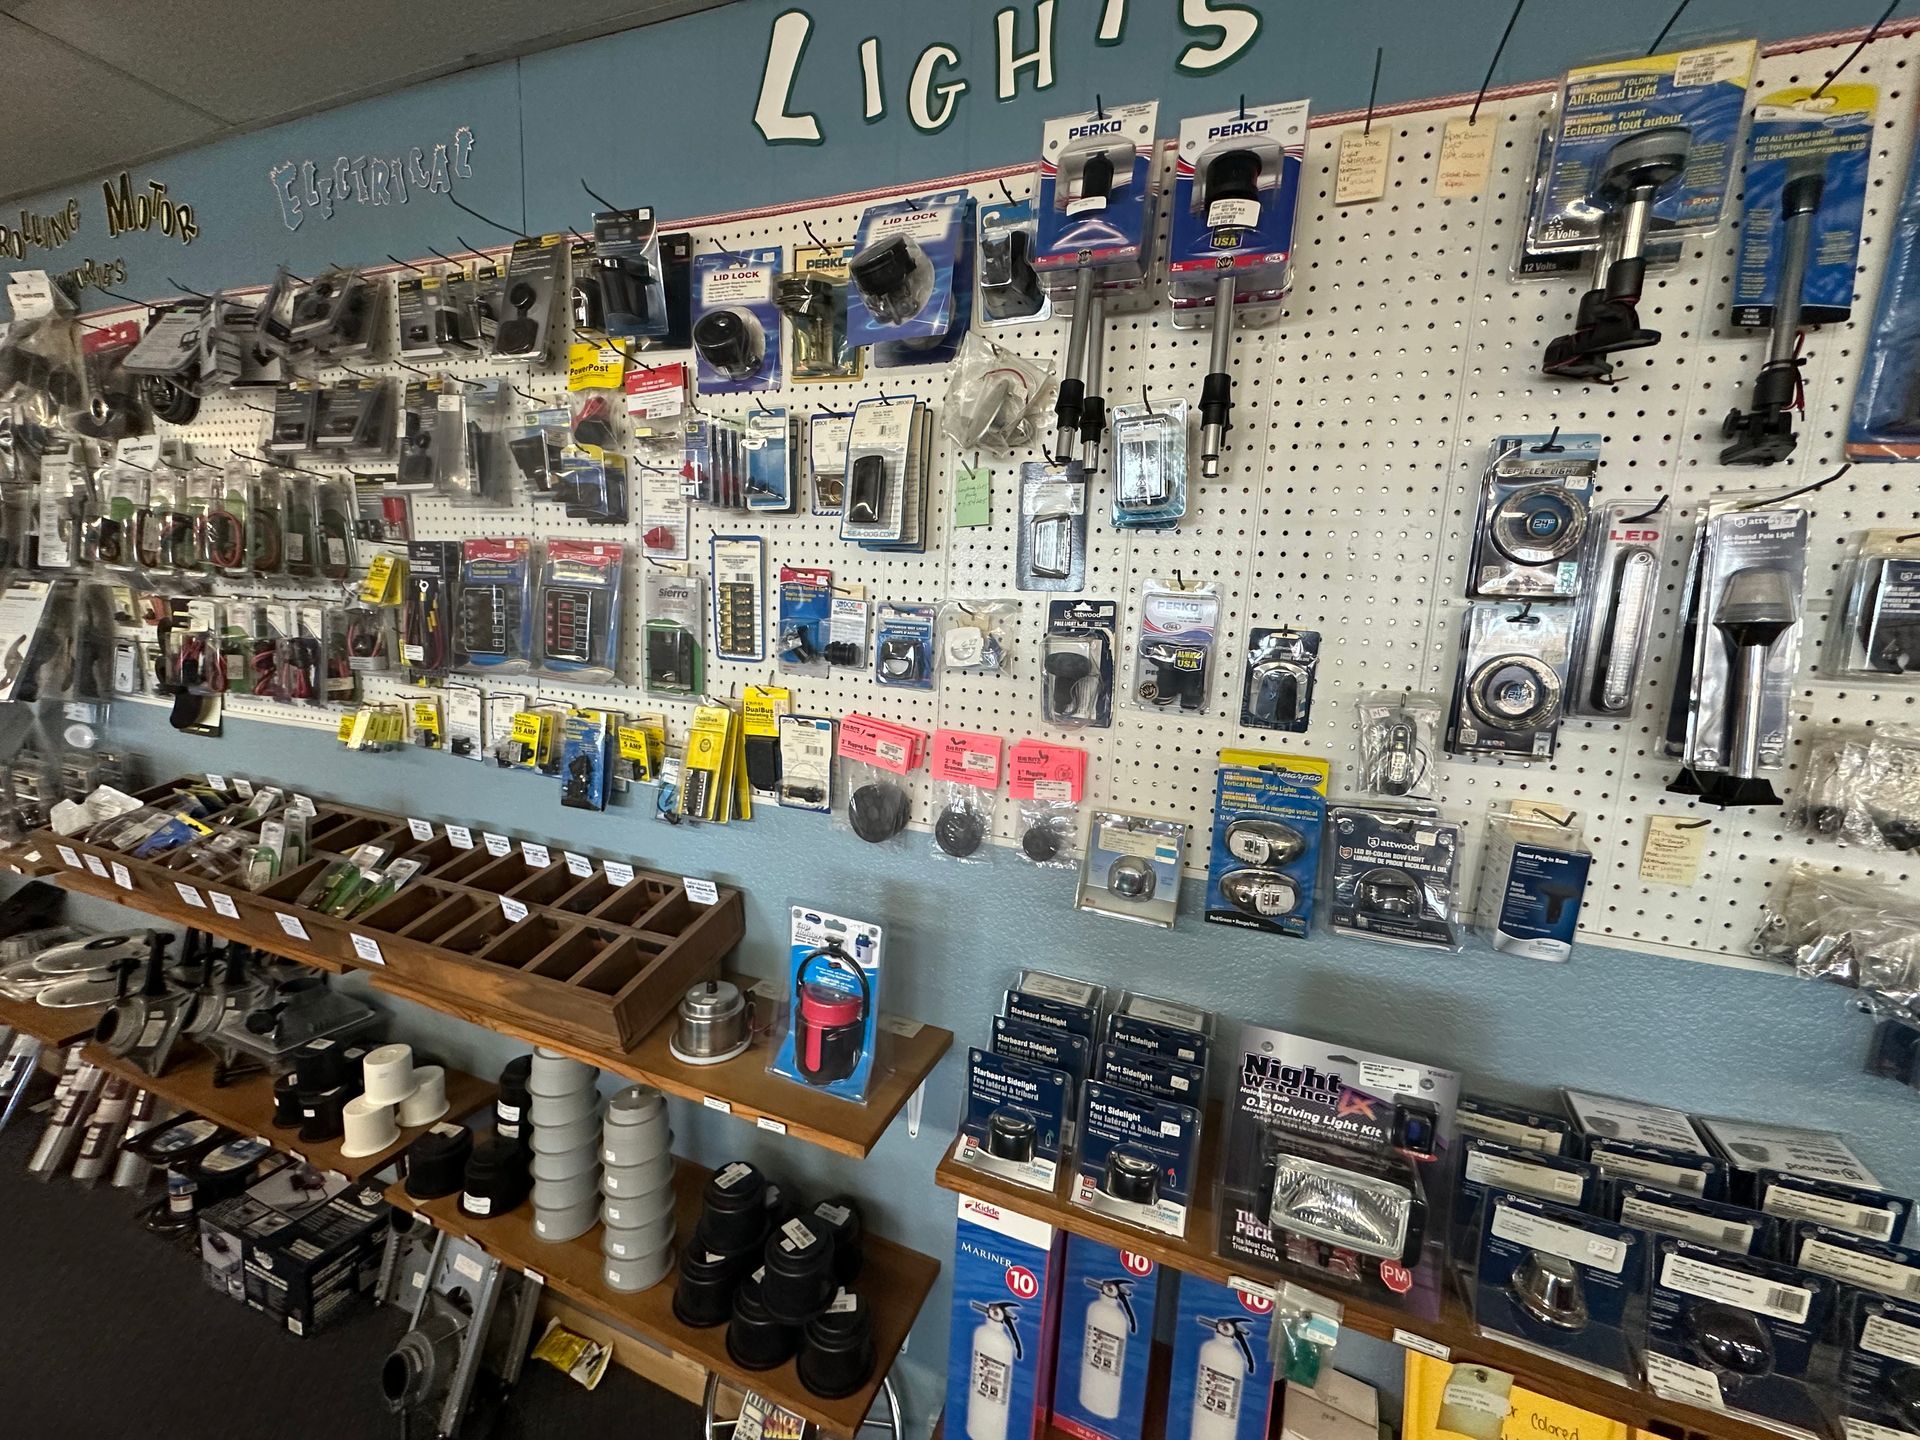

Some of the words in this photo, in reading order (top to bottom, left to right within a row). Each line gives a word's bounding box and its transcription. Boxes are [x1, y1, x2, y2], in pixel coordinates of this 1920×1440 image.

[1624, 75, 1659, 87] FOLDING
[1568, 92, 1625, 106] All-Round
[1628, 85, 1657, 99] Light
[1618, 109, 1646, 119] PLIANT
[1068, 120, 1122, 139] PERKO
[1208, 119, 1268, 139] PERKO
[1564, 123, 1616, 137] Eclairage
[1619, 118, 1641, 131] tout
[1643, 113, 1683, 128] autour
[1770, 135, 1782, 143] ALL
[270, 126, 474, 231] ELECTRICAL
[102, 171, 199, 246] MOTOR
[883, 217, 902, 225] LID
[905, 212, 938, 221] LOCK
[1213, 236, 1237, 246] USA
[1544, 230, 1554, 240] 12
[1556, 229, 1580, 239] Volts
[1535, 262, 1557, 271] Volts
[713, 273, 729, 281] LID
[732, 271, 760, 279] LOCK
[569, 363, 609, 376] PowerPost
[1609, 530, 1660, 541] LED
[1759, 532, 1774, 540] Pole
[1776, 531, 1795, 539] Light
[658, 588, 689, 598] Sierra
[1157, 601, 1200, 612] PERKO
[1177, 660, 1198, 669] USA
[746, 706, 774, 714] DualBus
[524, 728, 537, 736] AMP
[629, 742, 642, 751] AMP
[1277, 772, 1322, 783] marpac
[1265, 783, 1279, 791] Side
[1279, 785, 1297, 793] Lights
[1296, 808, 1318, 817] vertical
[1380, 840, 1420, 851] attwood
[1010, 1006, 1039, 1021] Starboard
[1041, 1014, 1067, 1027] Sidelight
[997, 1033, 1028, 1048] Starboard
[1029, 1042, 1057, 1055] Sidelight
[1115, 1031, 1128, 1040] Port
[1130, 1035, 1159, 1048] Sidelight
[973, 1066, 1006, 1084] Starboard
[1007, 1076, 1037, 1092] Sidelight
[1106, 1062, 1121, 1072] Port
[1122, 1067, 1153, 1082] Sidelight
[1243, 1051, 1342, 1093] Night
[973, 1075, 985, 1085] Feu
[1015, 1088, 1039, 1101] tribord
[1243, 1072, 1338, 1106] Watcher
[1272, 1093, 1290, 1103] Bulb
[1089, 1111, 1102, 1121] Feu
[1104, 1113, 1129, 1129] latéral
[1090, 1101, 1106, 1112] Port
[1107, 1106, 1141, 1123] Sidelight
[1273, 1103, 1322, 1123] Driving
[1323, 1115, 1359, 1132] Light
[1360, 1124, 1382, 1138] Kit
[1785, 1162, 1841, 1176] attwood
[974, 1201, 1000, 1216] Kidde
[1232, 1235, 1244, 1244] Fits
[1245, 1239, 1261, 1249] Most
[1261, 1244, 1276, 1254] Cars
[1232, 1242, 1253, 1254] Trucks
[1260, 1250, 1279, 1262] SUV's
[1687, 1244, 1719, 1256] attwood
[961, 1241, 1013, 1270] MARINER
[1125, 1250, 1149, 1272] 10
[1010, 1270, 1034, 1294] 10
[1383, 1264, 1408, 1284] PM
[763, 1416, 801, 1440] SALE
[1530, 1411, 1579, 1440] Colored
